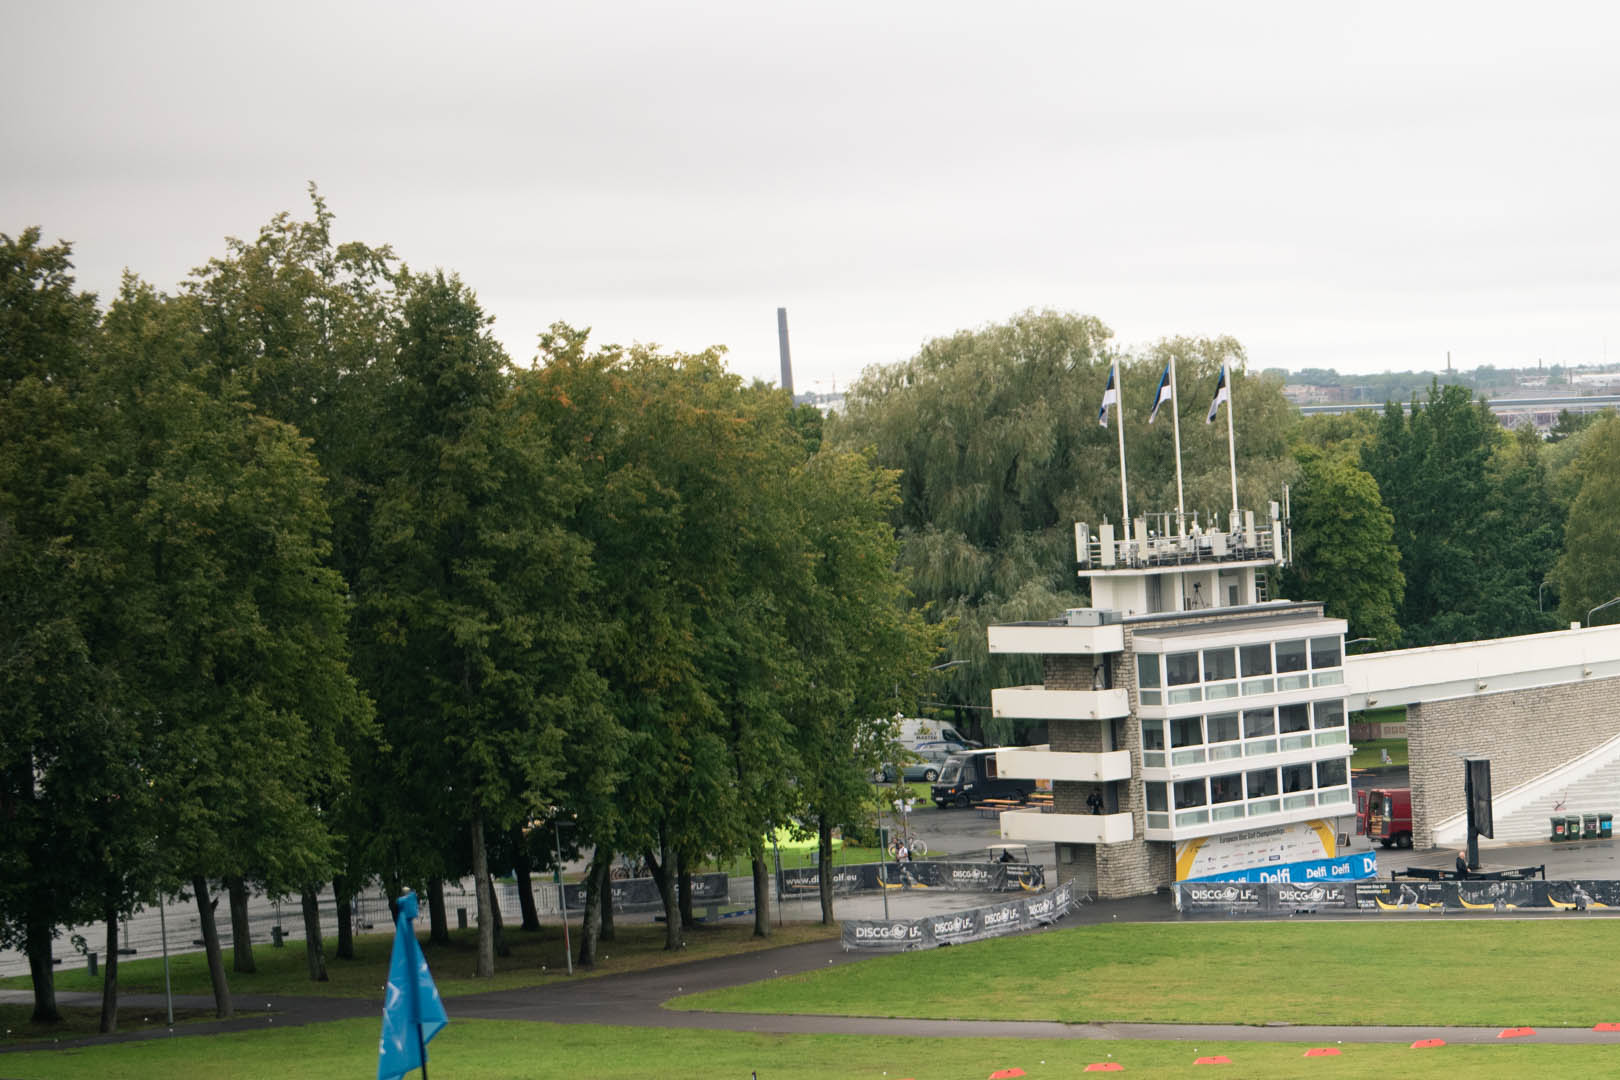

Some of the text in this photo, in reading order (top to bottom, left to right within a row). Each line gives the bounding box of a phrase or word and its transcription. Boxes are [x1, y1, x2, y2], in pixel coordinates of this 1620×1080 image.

[785, 874, 857, 885] www.diolf.eu
[1260, 863, 1350, 883] Delfi Delfi Delfi
